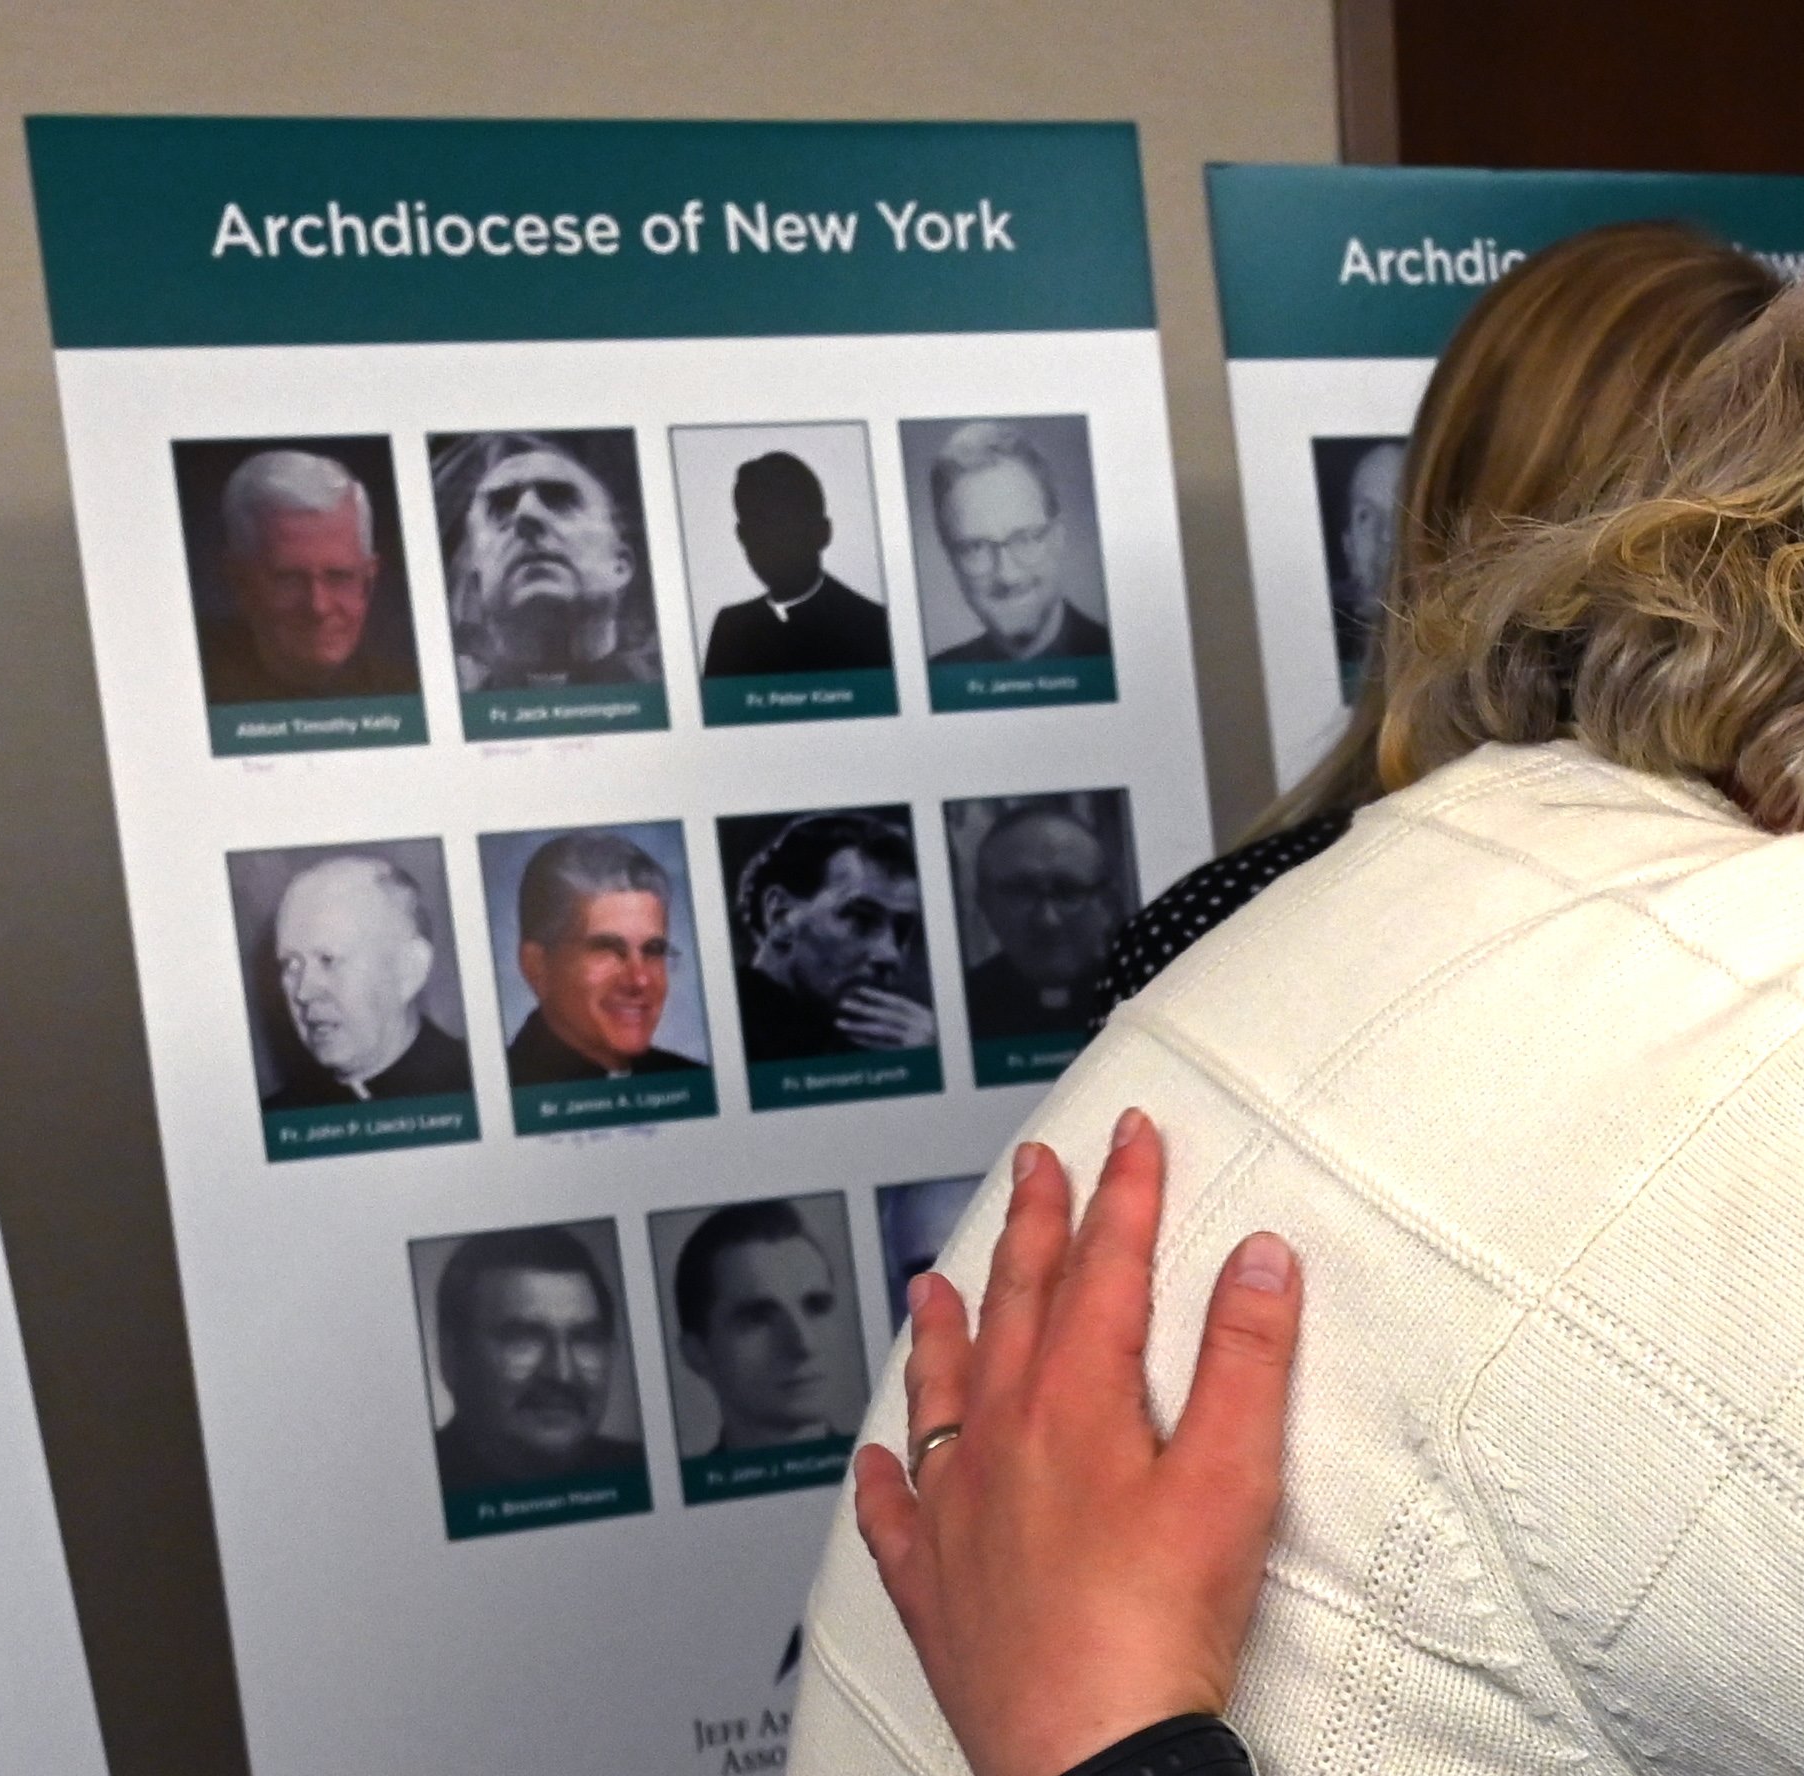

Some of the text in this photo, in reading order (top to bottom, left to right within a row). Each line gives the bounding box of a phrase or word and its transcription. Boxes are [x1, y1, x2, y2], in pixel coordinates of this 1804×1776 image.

[210, 200, 1016, 258] Archdiocese of New York
[290, 717, 359, 735] Timothy
[360, 714, 402, 732] Kelly
[513, 706, 550, 723] Jack
